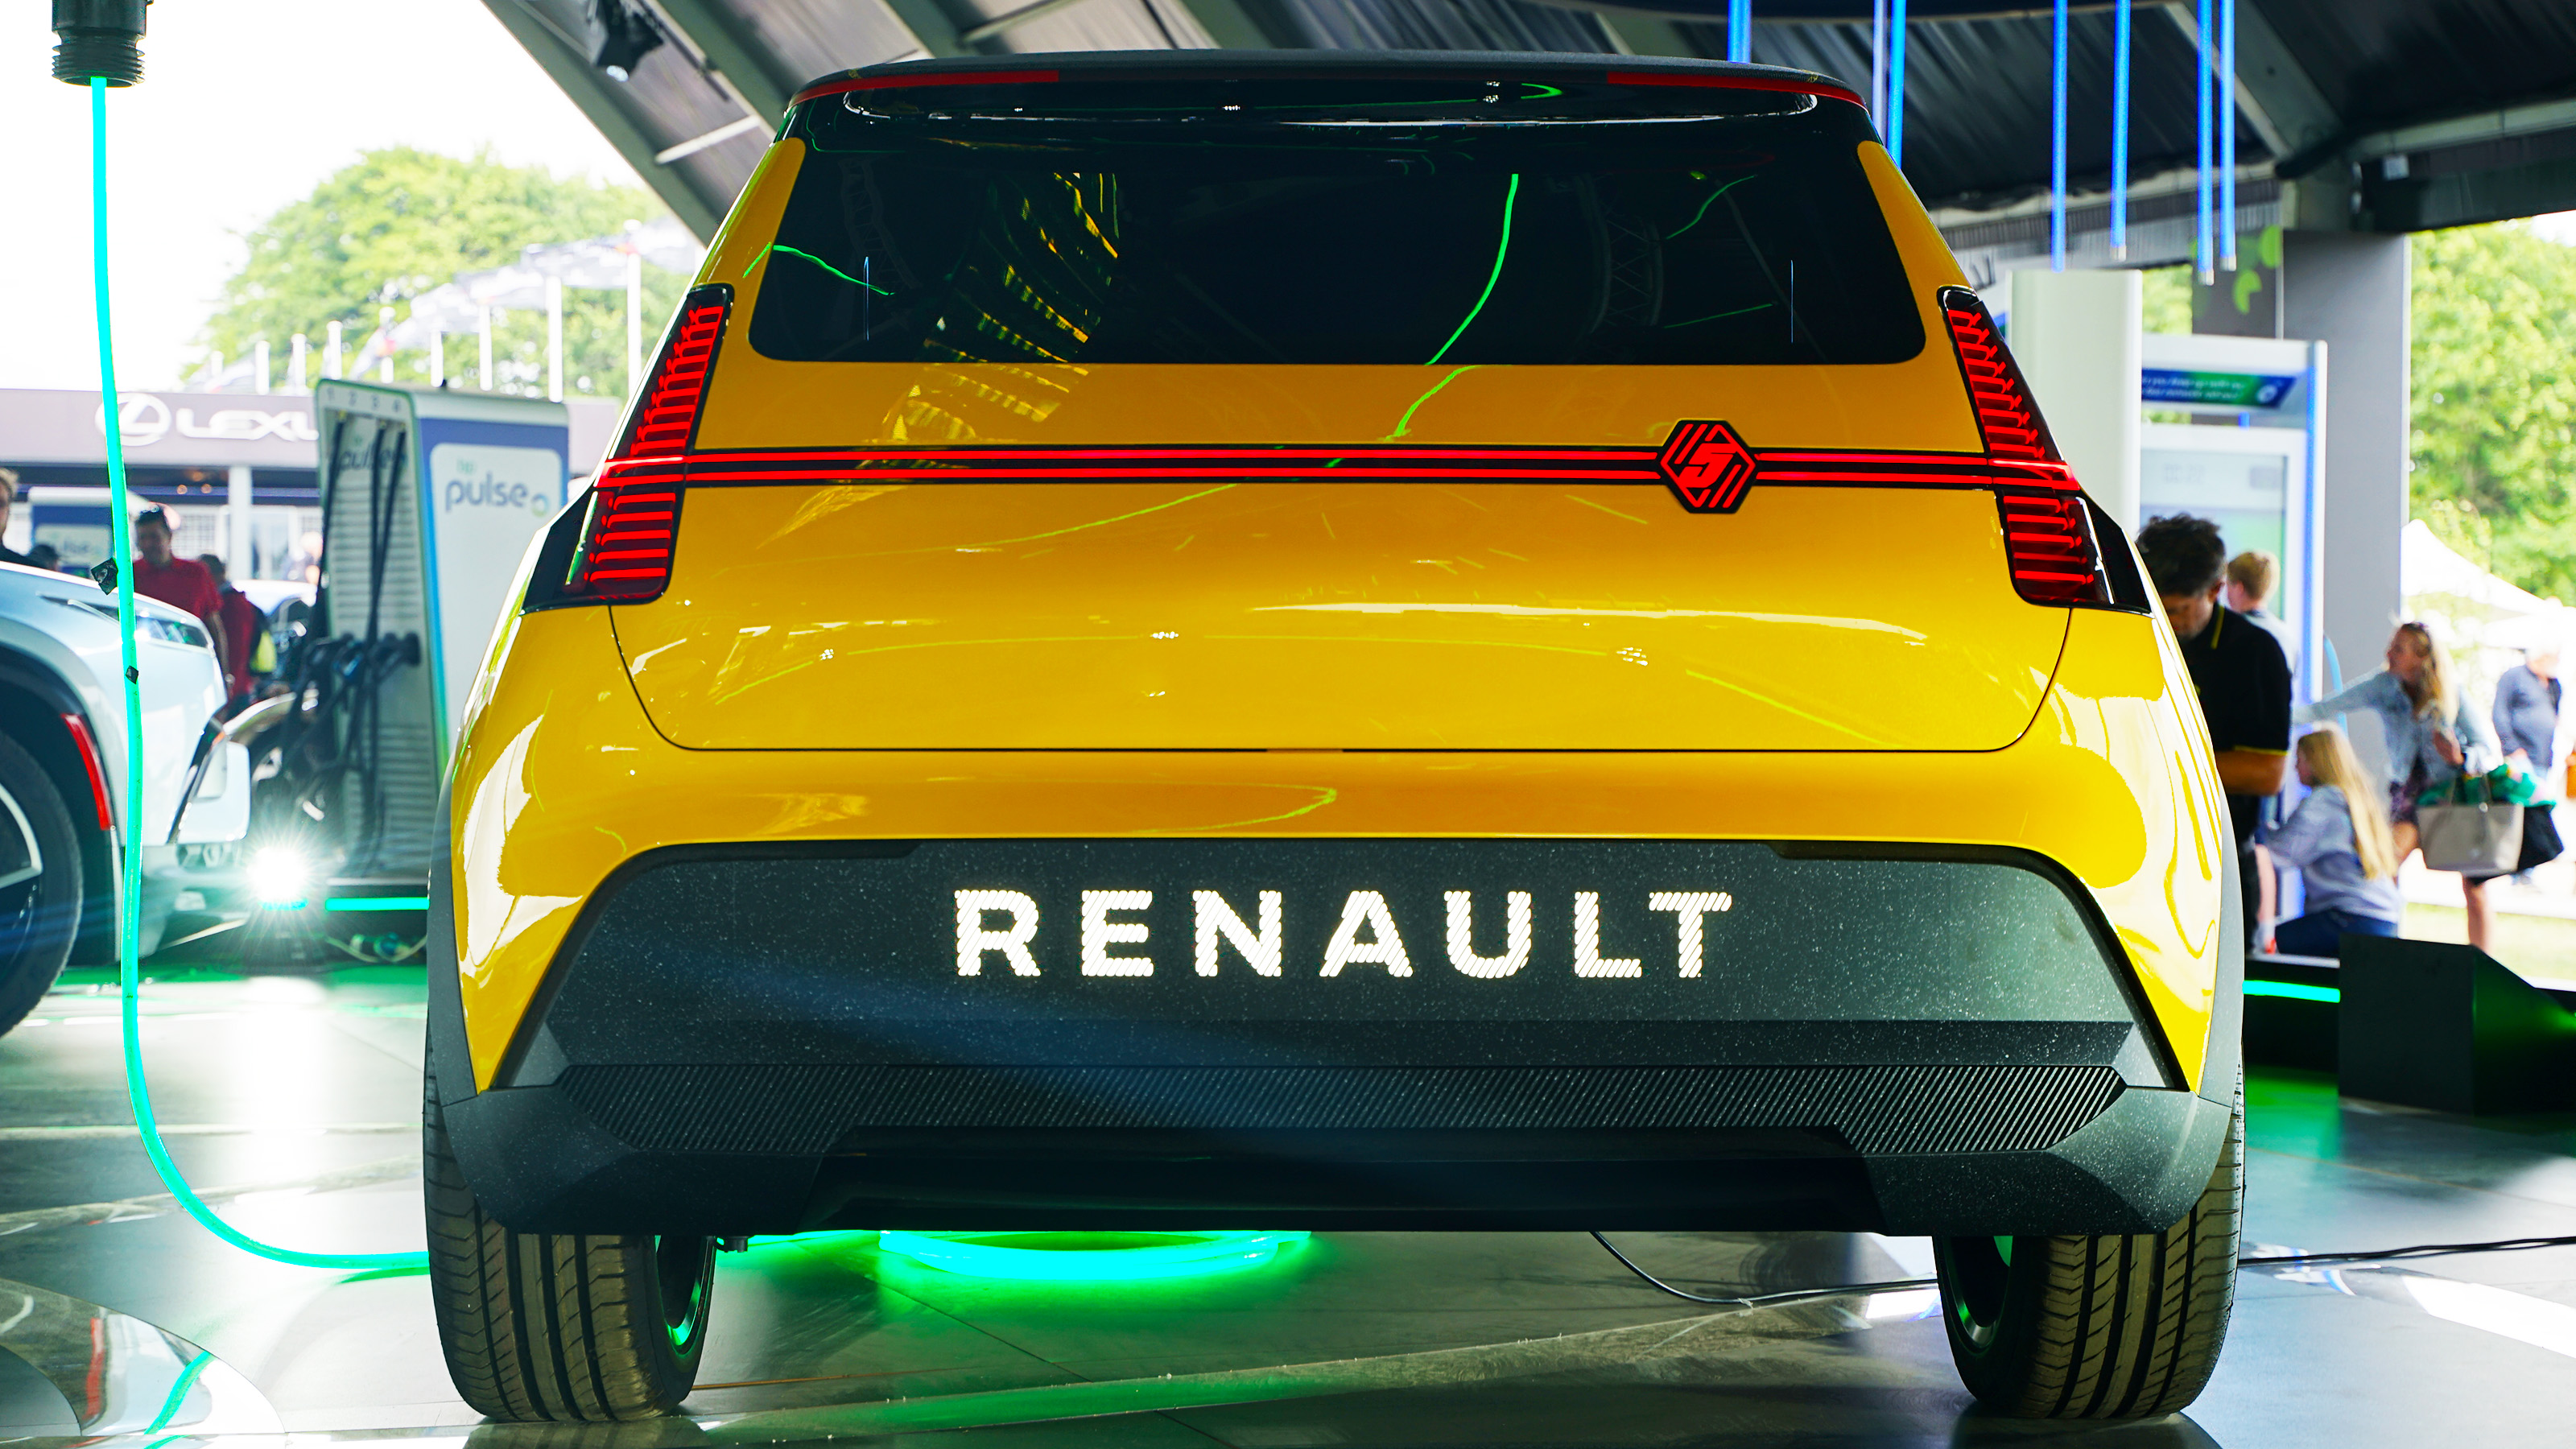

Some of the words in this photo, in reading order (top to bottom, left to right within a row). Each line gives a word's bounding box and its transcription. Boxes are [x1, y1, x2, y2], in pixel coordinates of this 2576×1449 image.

[176, 408, 320, 442] LEXU
[444, 471, 529, 513] pulse
[955, 890, 1733, 978] RENAULT
